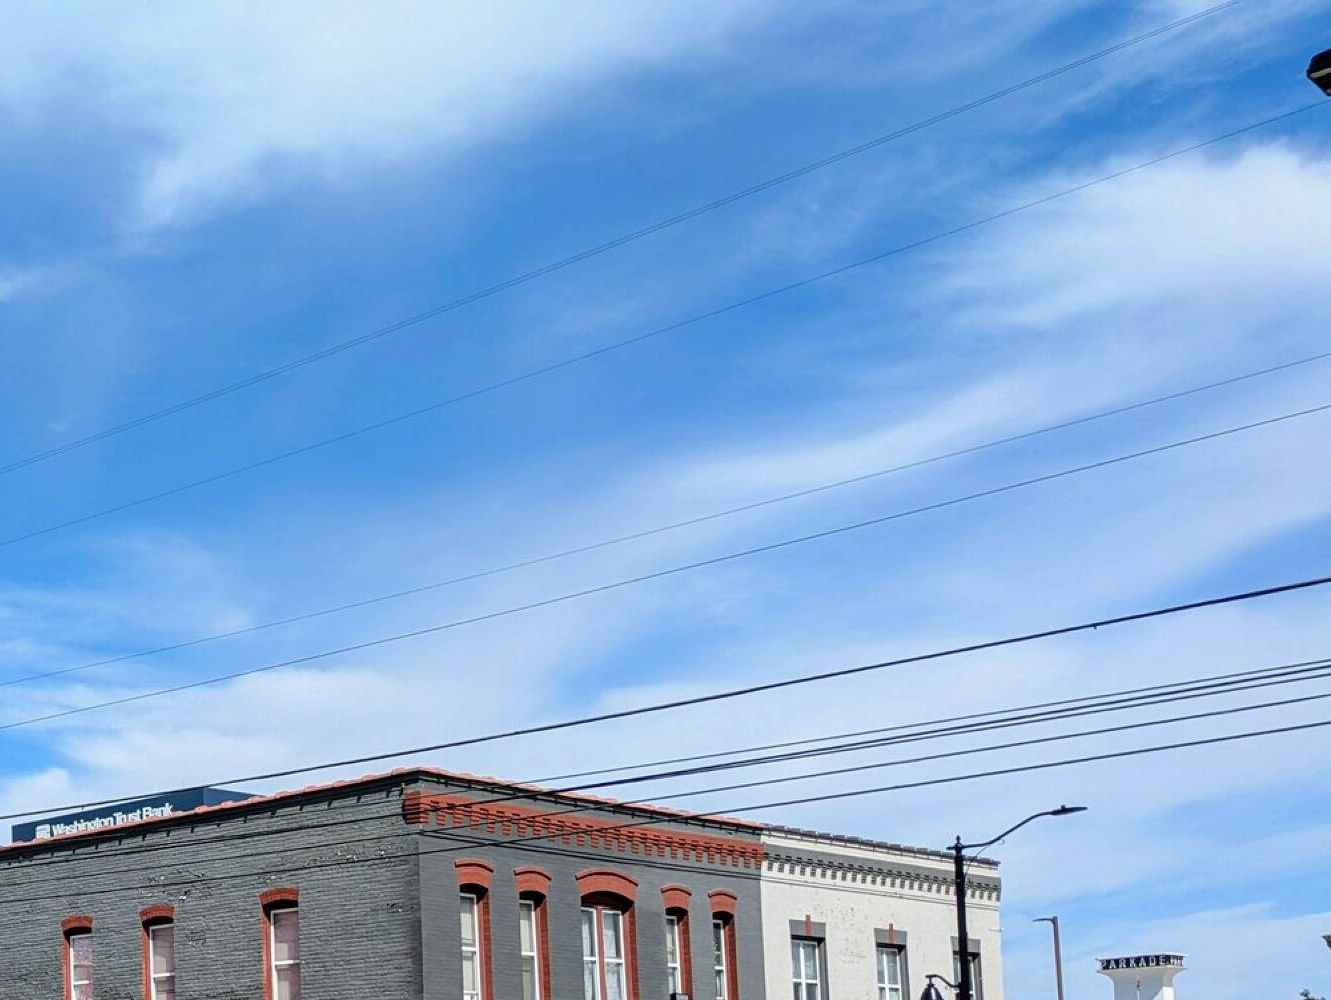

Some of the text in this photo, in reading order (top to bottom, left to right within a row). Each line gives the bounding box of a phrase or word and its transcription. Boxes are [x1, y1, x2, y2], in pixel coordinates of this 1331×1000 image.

[52, 802, 173, 836] Washington Trust Bank
[1100, 955, 1167, 969] PARKADE
